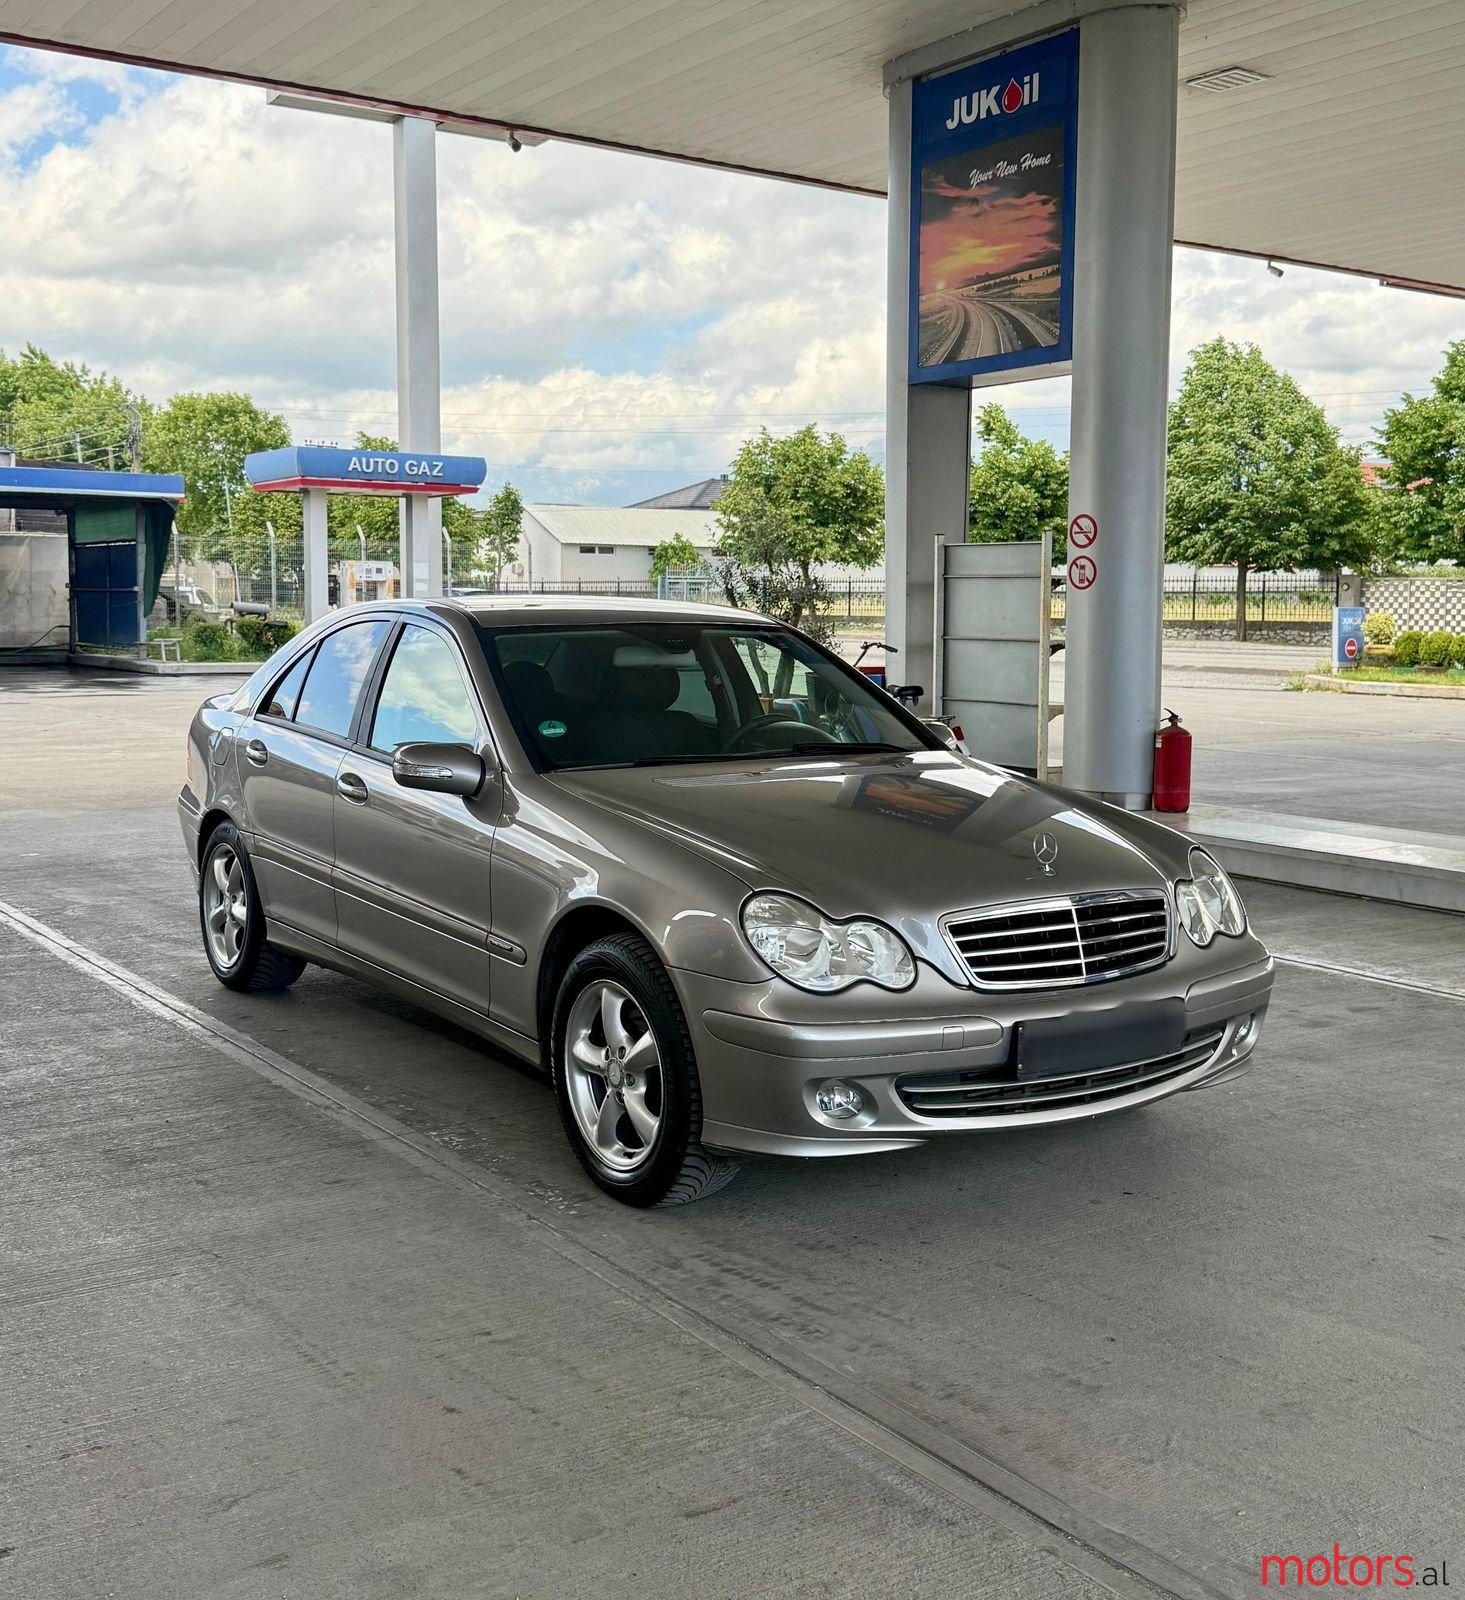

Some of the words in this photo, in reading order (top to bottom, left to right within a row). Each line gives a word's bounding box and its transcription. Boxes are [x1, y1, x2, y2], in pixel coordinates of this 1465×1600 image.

[969, 168, 993, 189] Your
[996, 160, 1018, 178] New
[1020, 153, 1052, 171] Home
[348, 456, 399, 474] AUTO
[404, 460, 444, 476] GAZ
